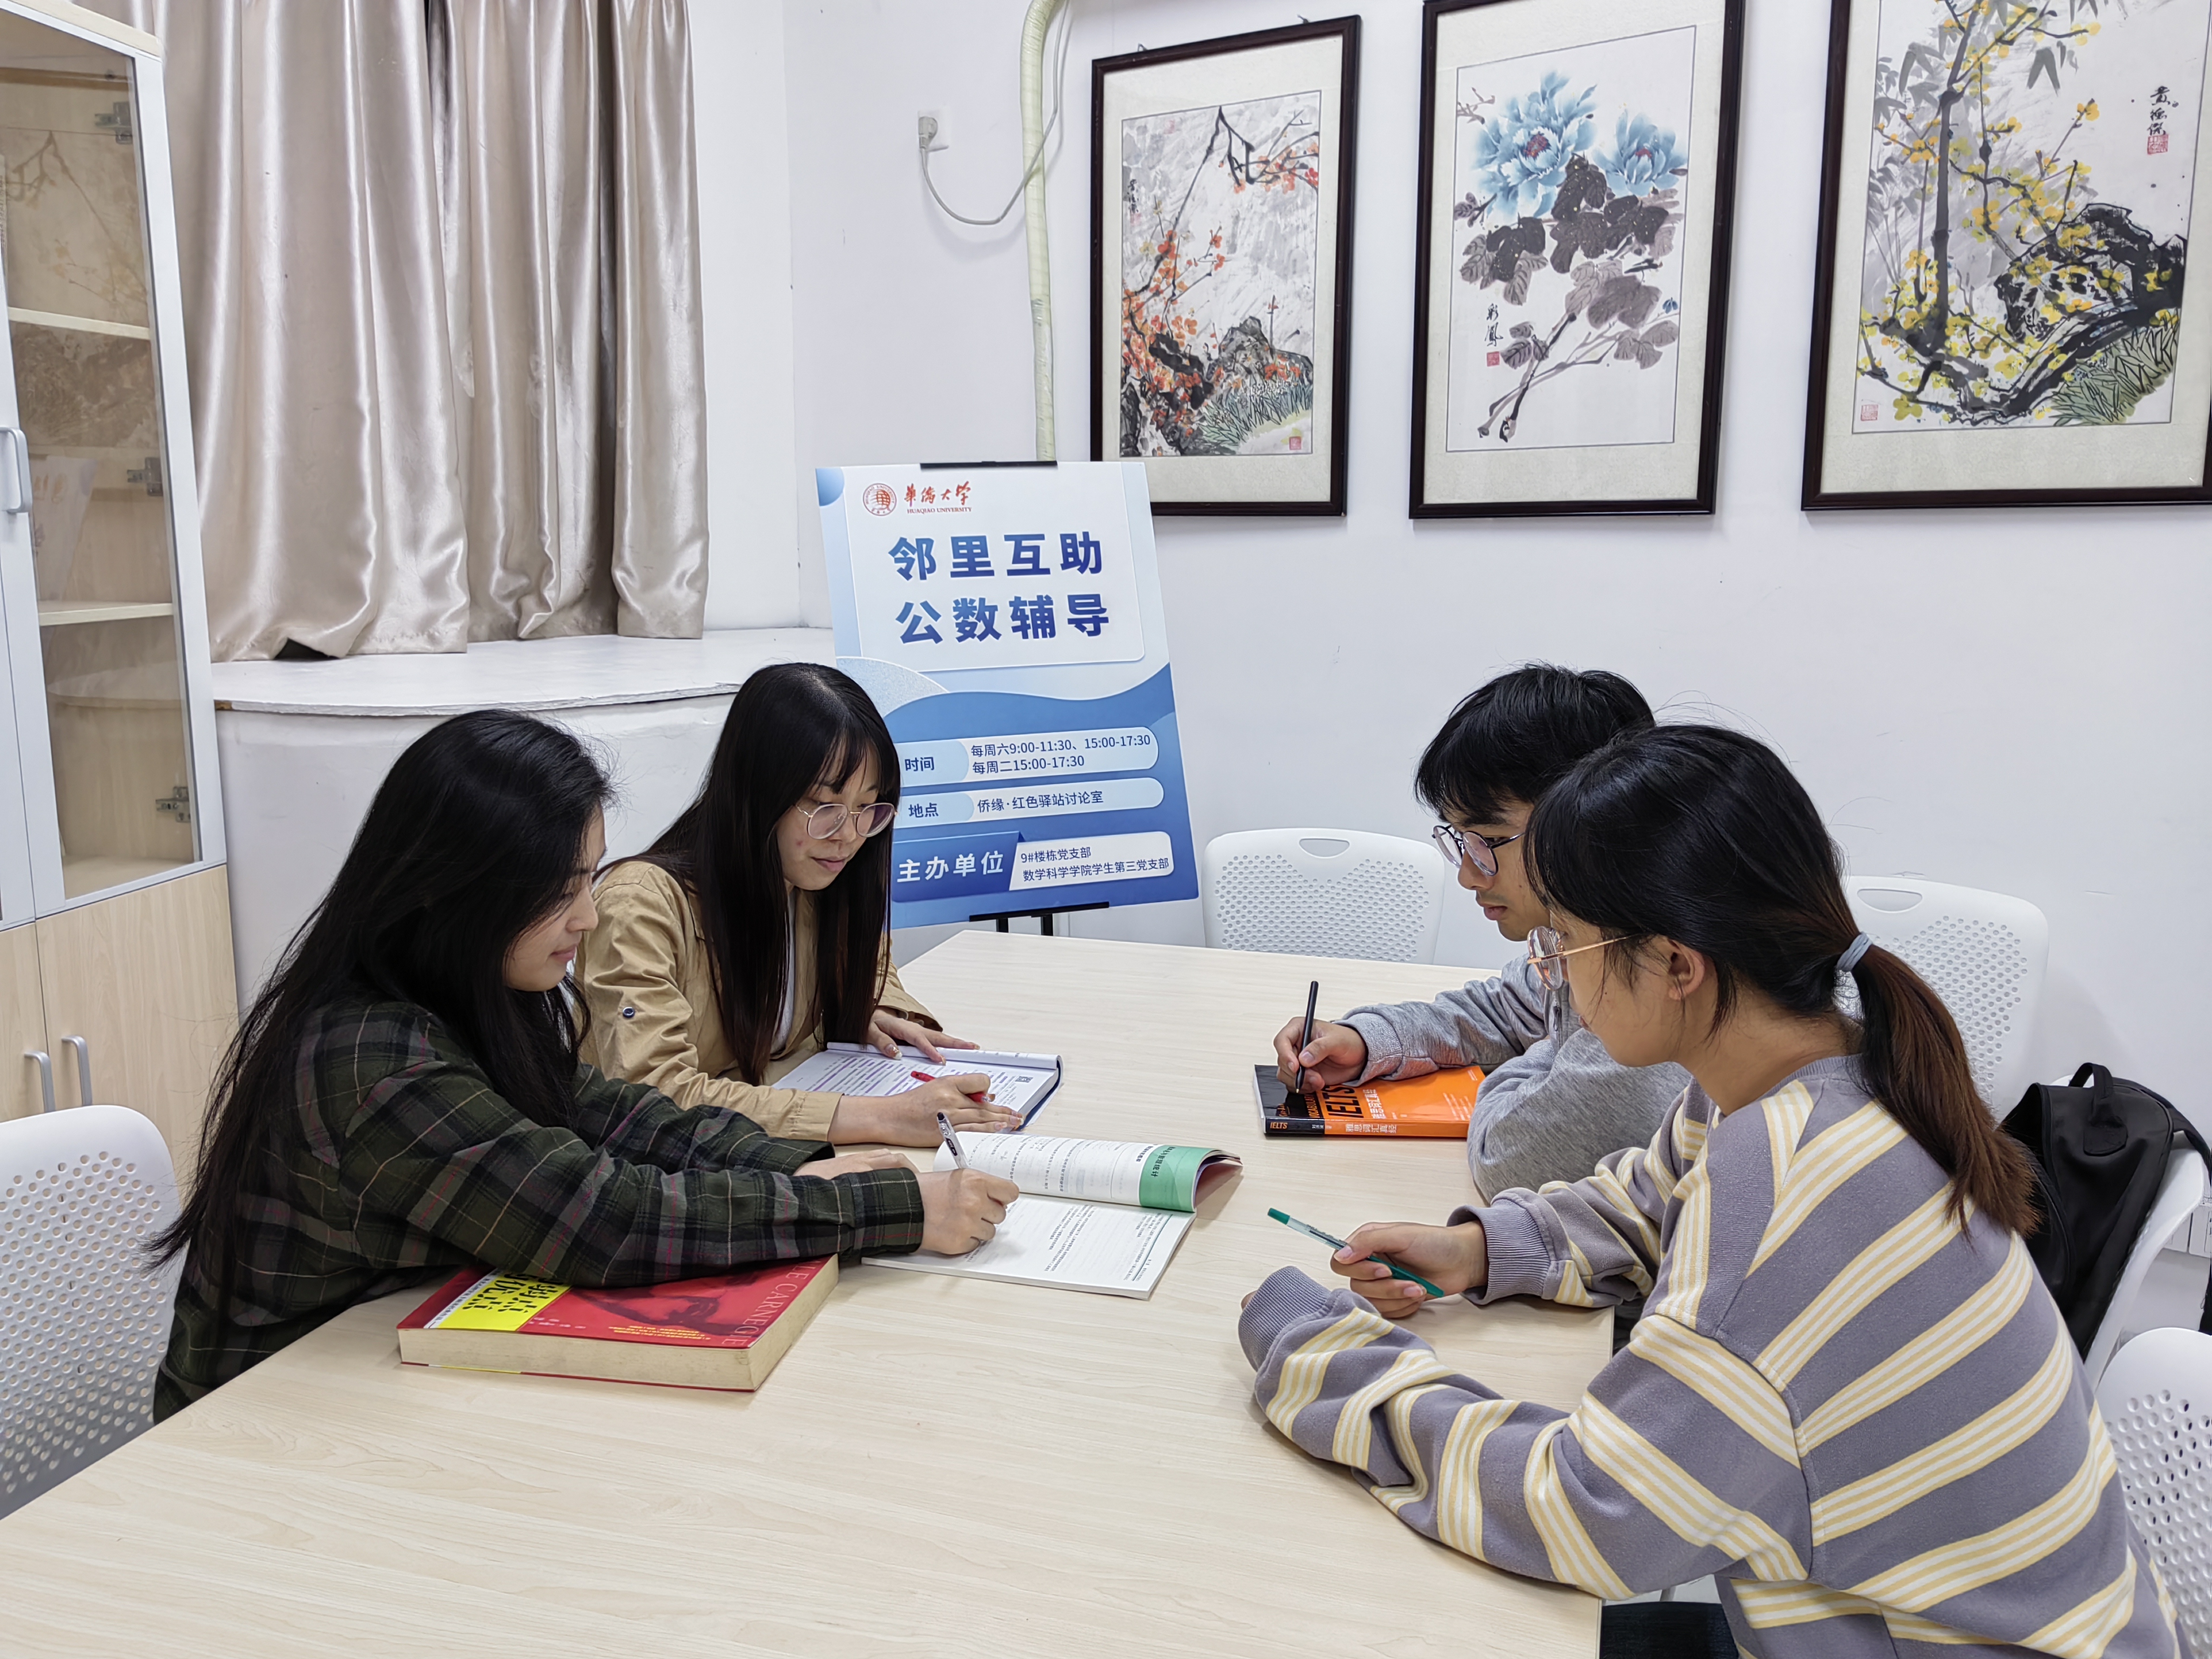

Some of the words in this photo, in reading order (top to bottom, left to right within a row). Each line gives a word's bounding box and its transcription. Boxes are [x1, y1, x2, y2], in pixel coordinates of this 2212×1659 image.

[888, 531, 1102, 581] 邻里互助
[895, 594, 1109, 644] 公数辅导
[905, 757, 935, 772] 时间
[972, 755, 1085, 774] 每周二15:00-17:30
[908, 802, 939, 818] 地点
[1021, 846, 1091, 862] 9#楼栋党支部
[897, 851, 1003, 882] 主办单位
[1023, 858, 1169, 882] 数学科学学院学生第三党支部
[1321, 1085, 1364, 1118] IELTS
[1346, 1123, 1397, 1134] 雅思词汇真经
[721, 1283, 798, 1346] CARNEGIE
